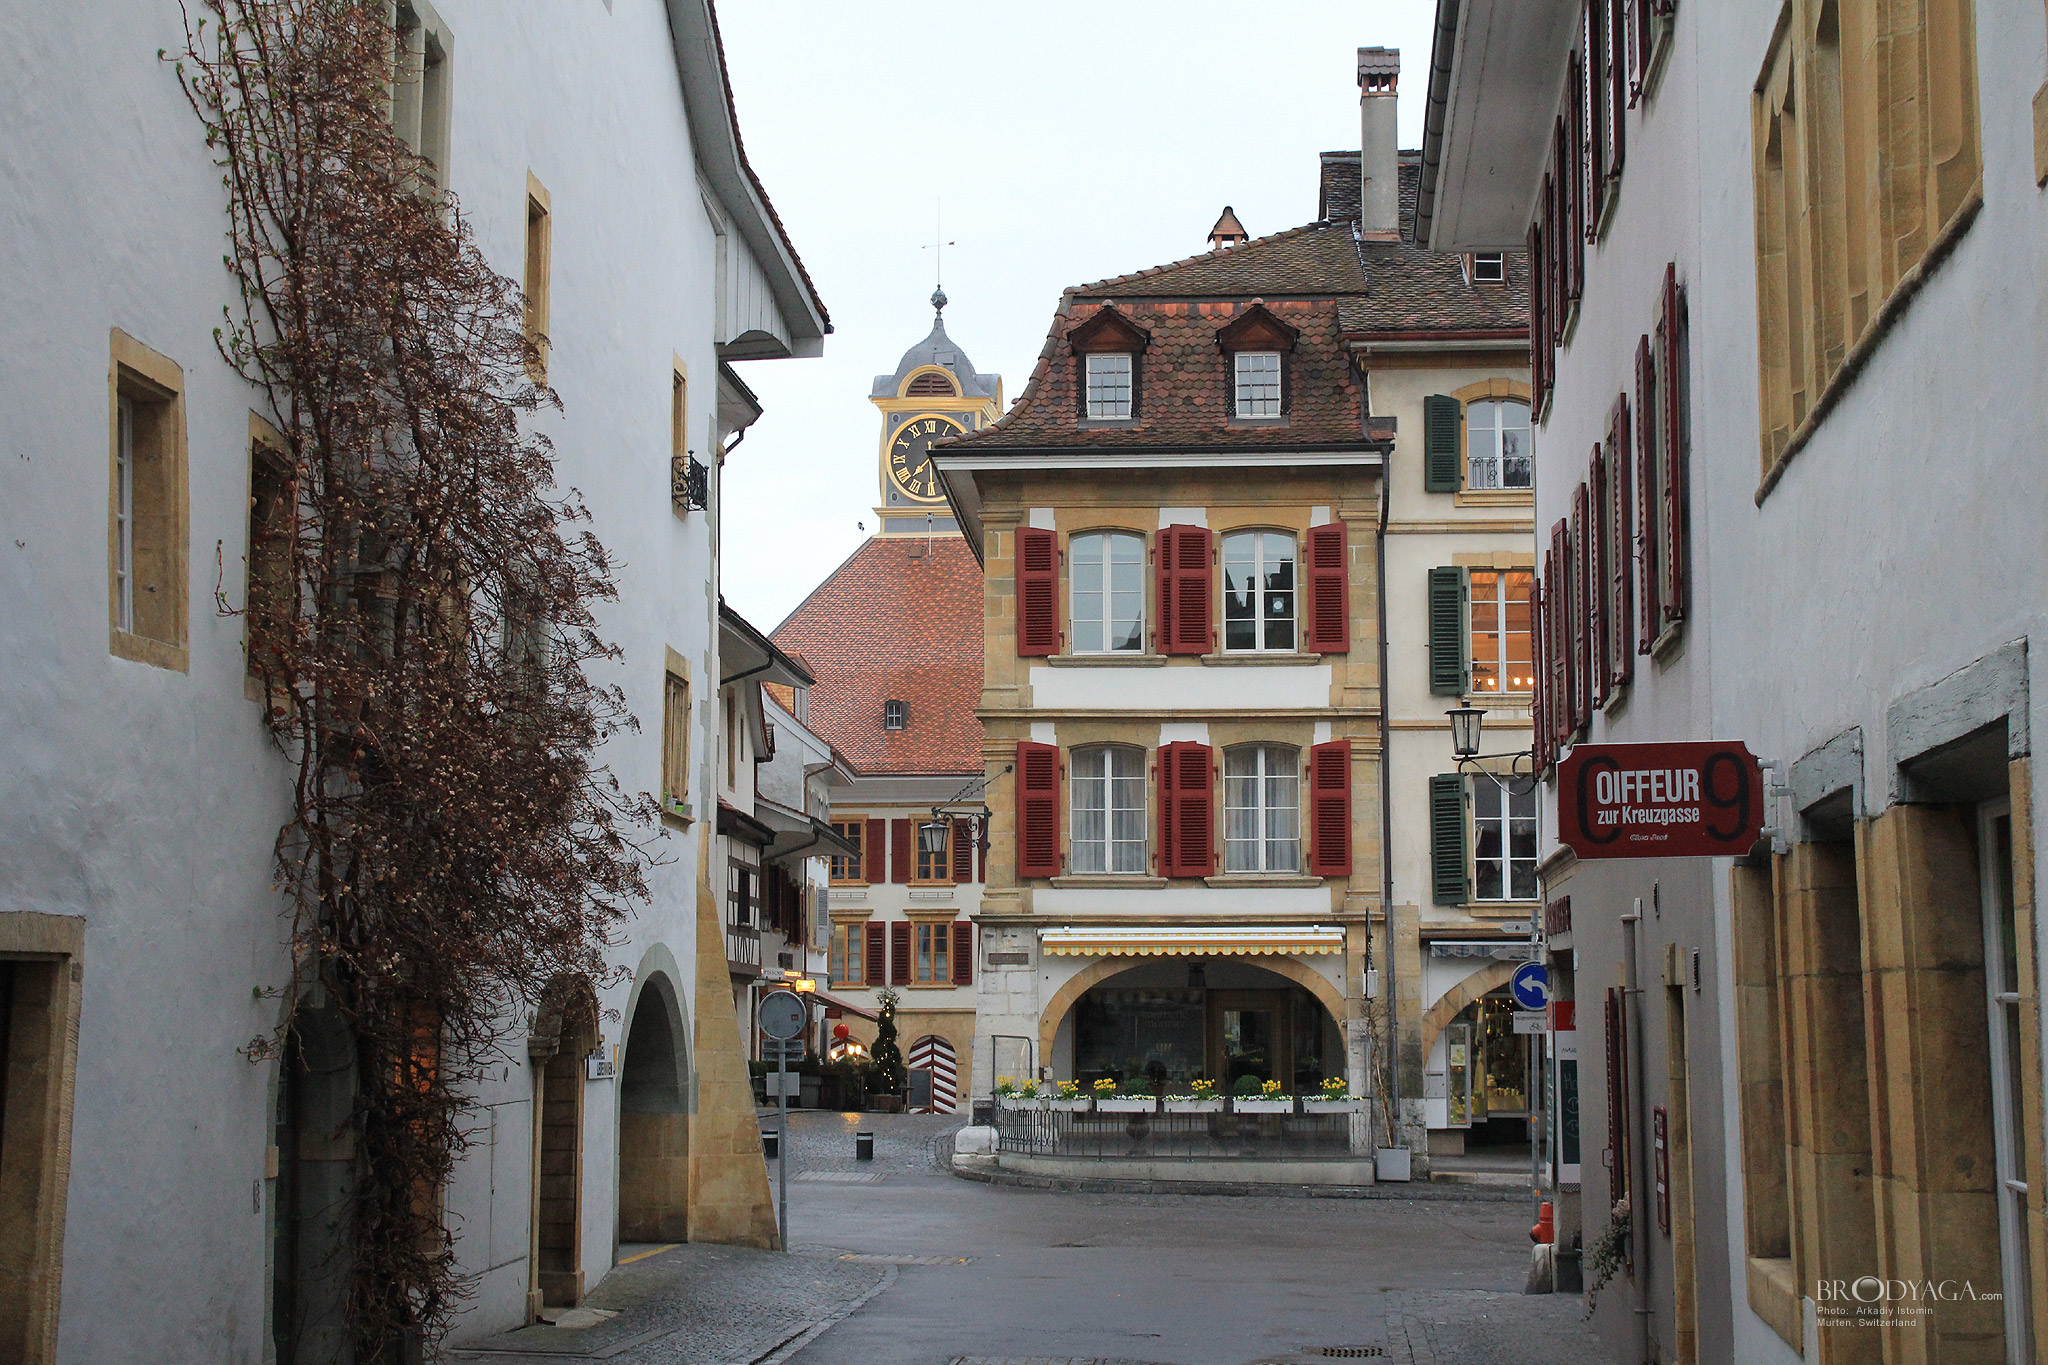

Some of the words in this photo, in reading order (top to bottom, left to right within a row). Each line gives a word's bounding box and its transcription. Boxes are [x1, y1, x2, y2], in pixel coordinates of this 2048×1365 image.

[924, 420, 936, 433] XII
[1597, 808, 1620, 825] zur
[1622, 805, 1700, 826] Kreuzgasse
